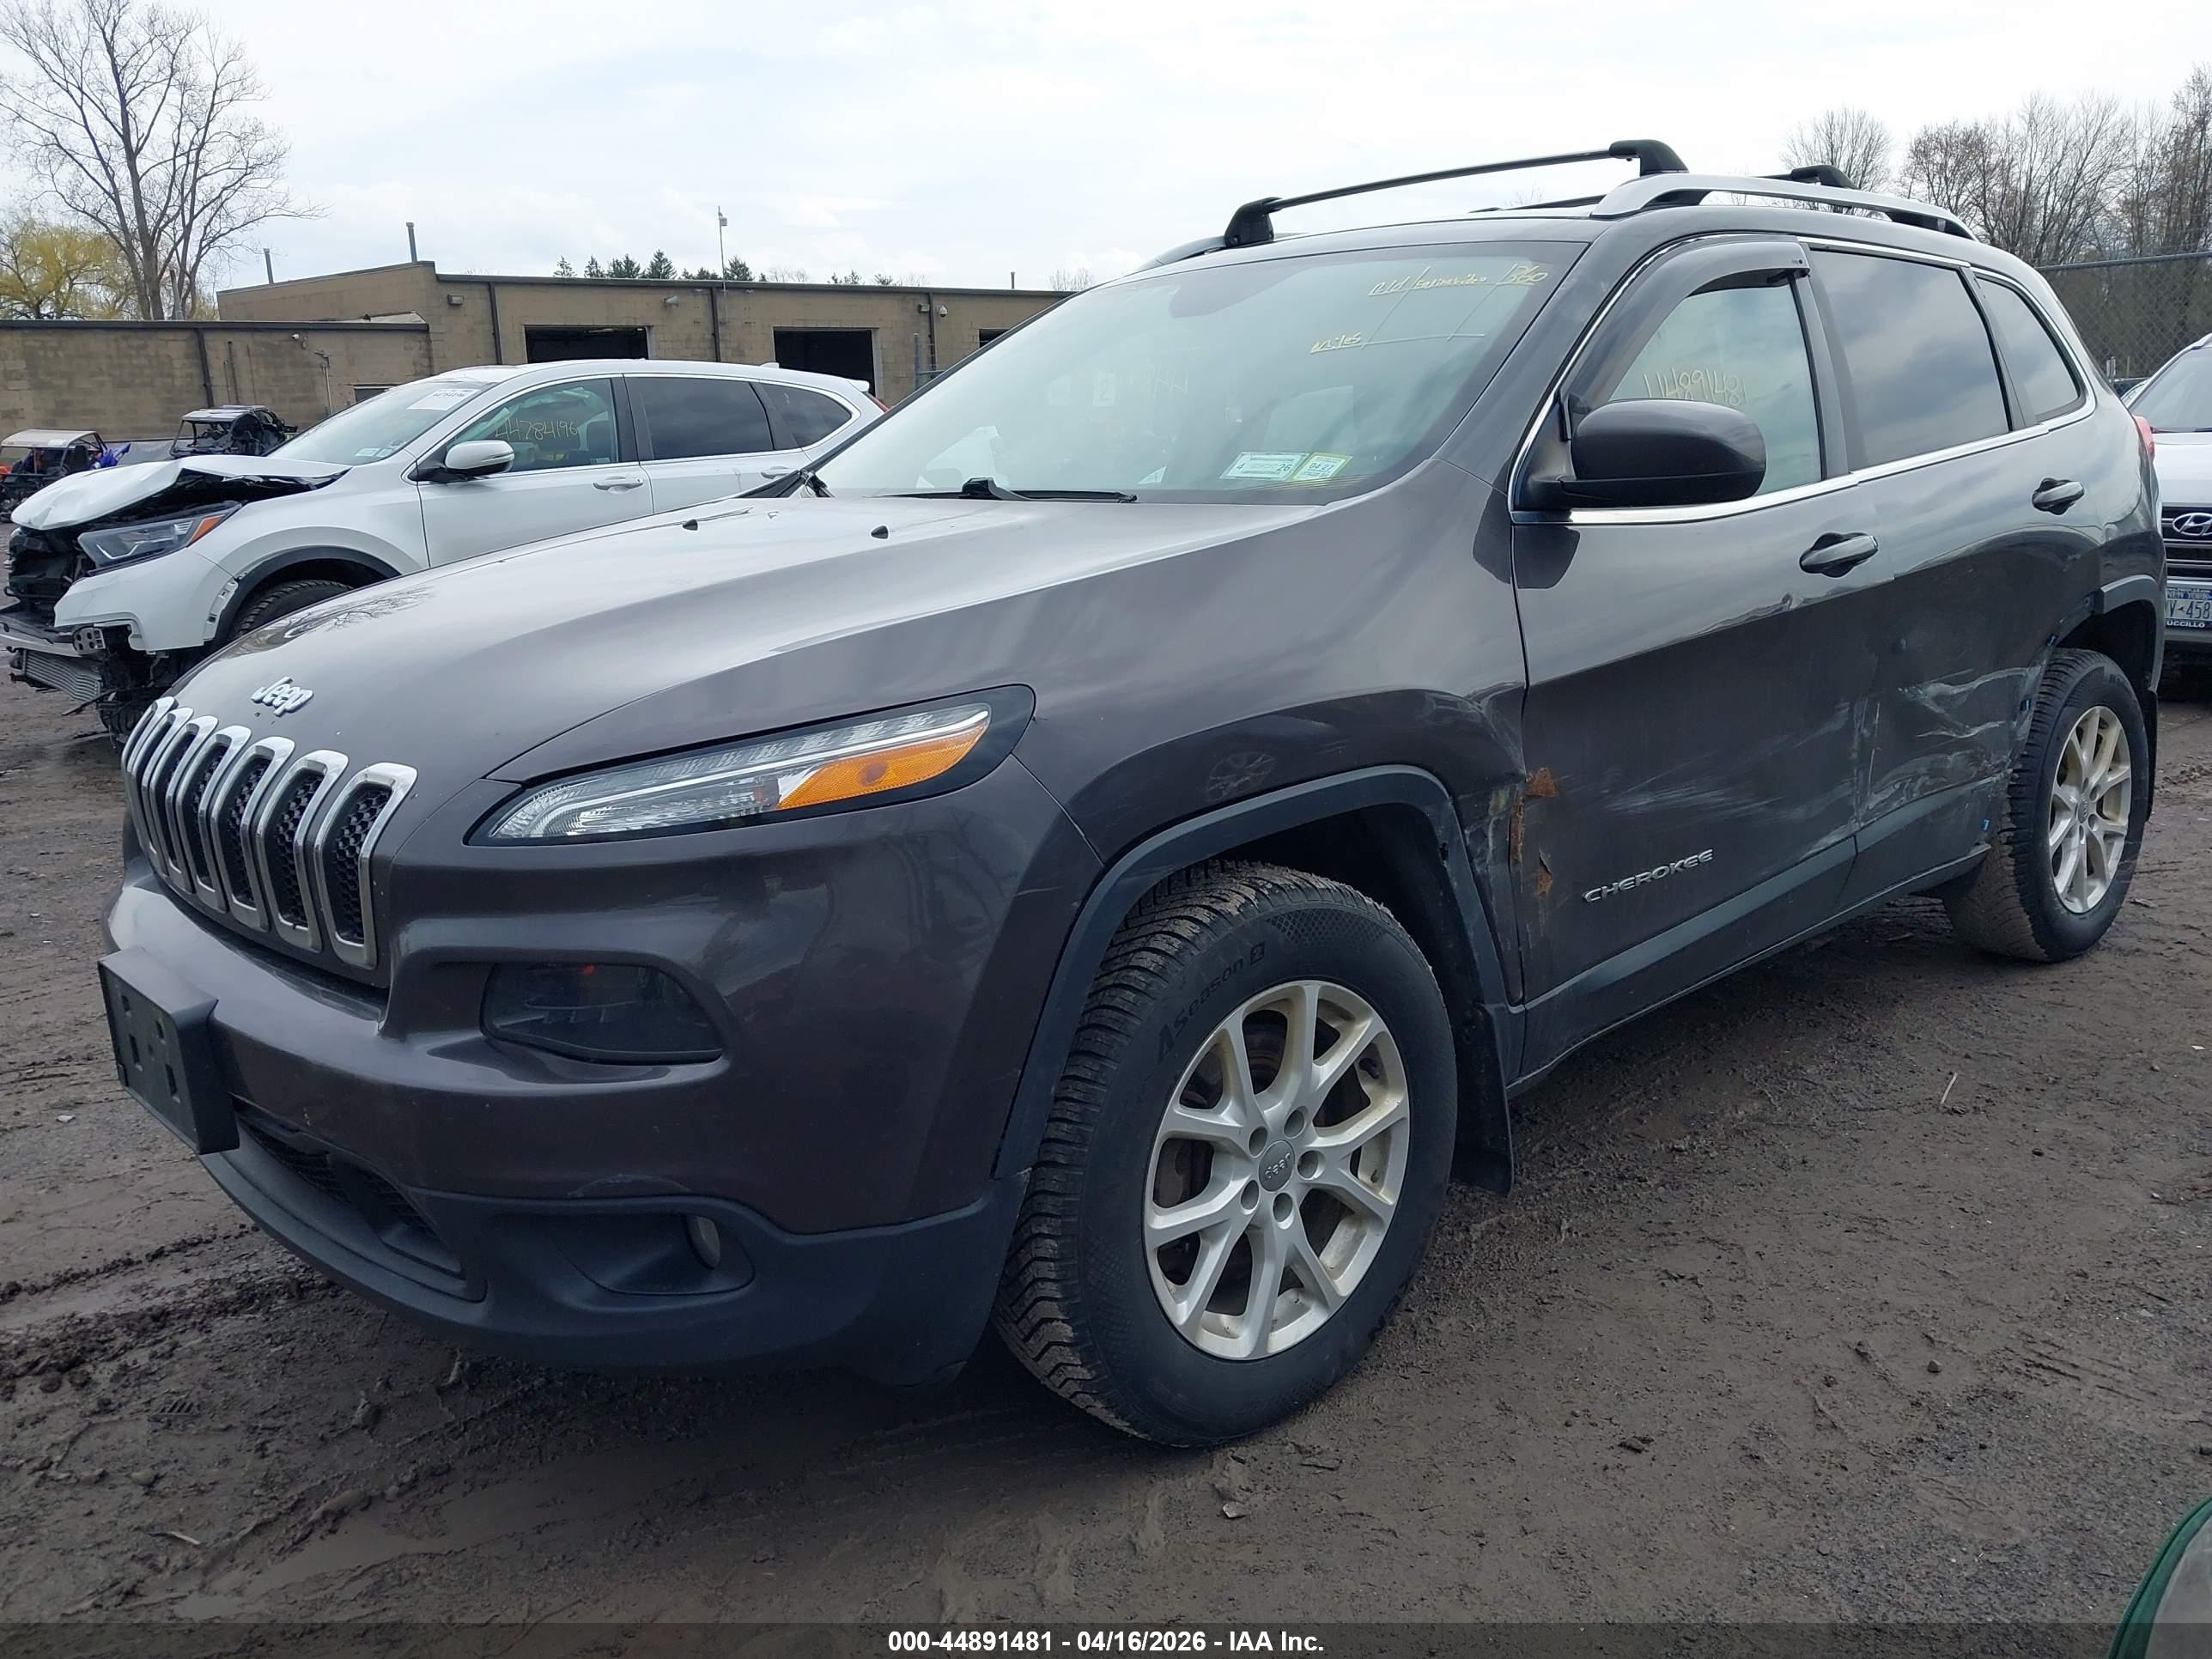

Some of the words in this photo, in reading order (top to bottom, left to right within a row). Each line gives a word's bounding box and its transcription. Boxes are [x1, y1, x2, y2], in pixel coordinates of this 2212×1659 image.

[495, 417, 578, 441] 44784196
[251, 676, 314, 717] Jeep
[1583, 848, 1714, 902] CHEROKEE
